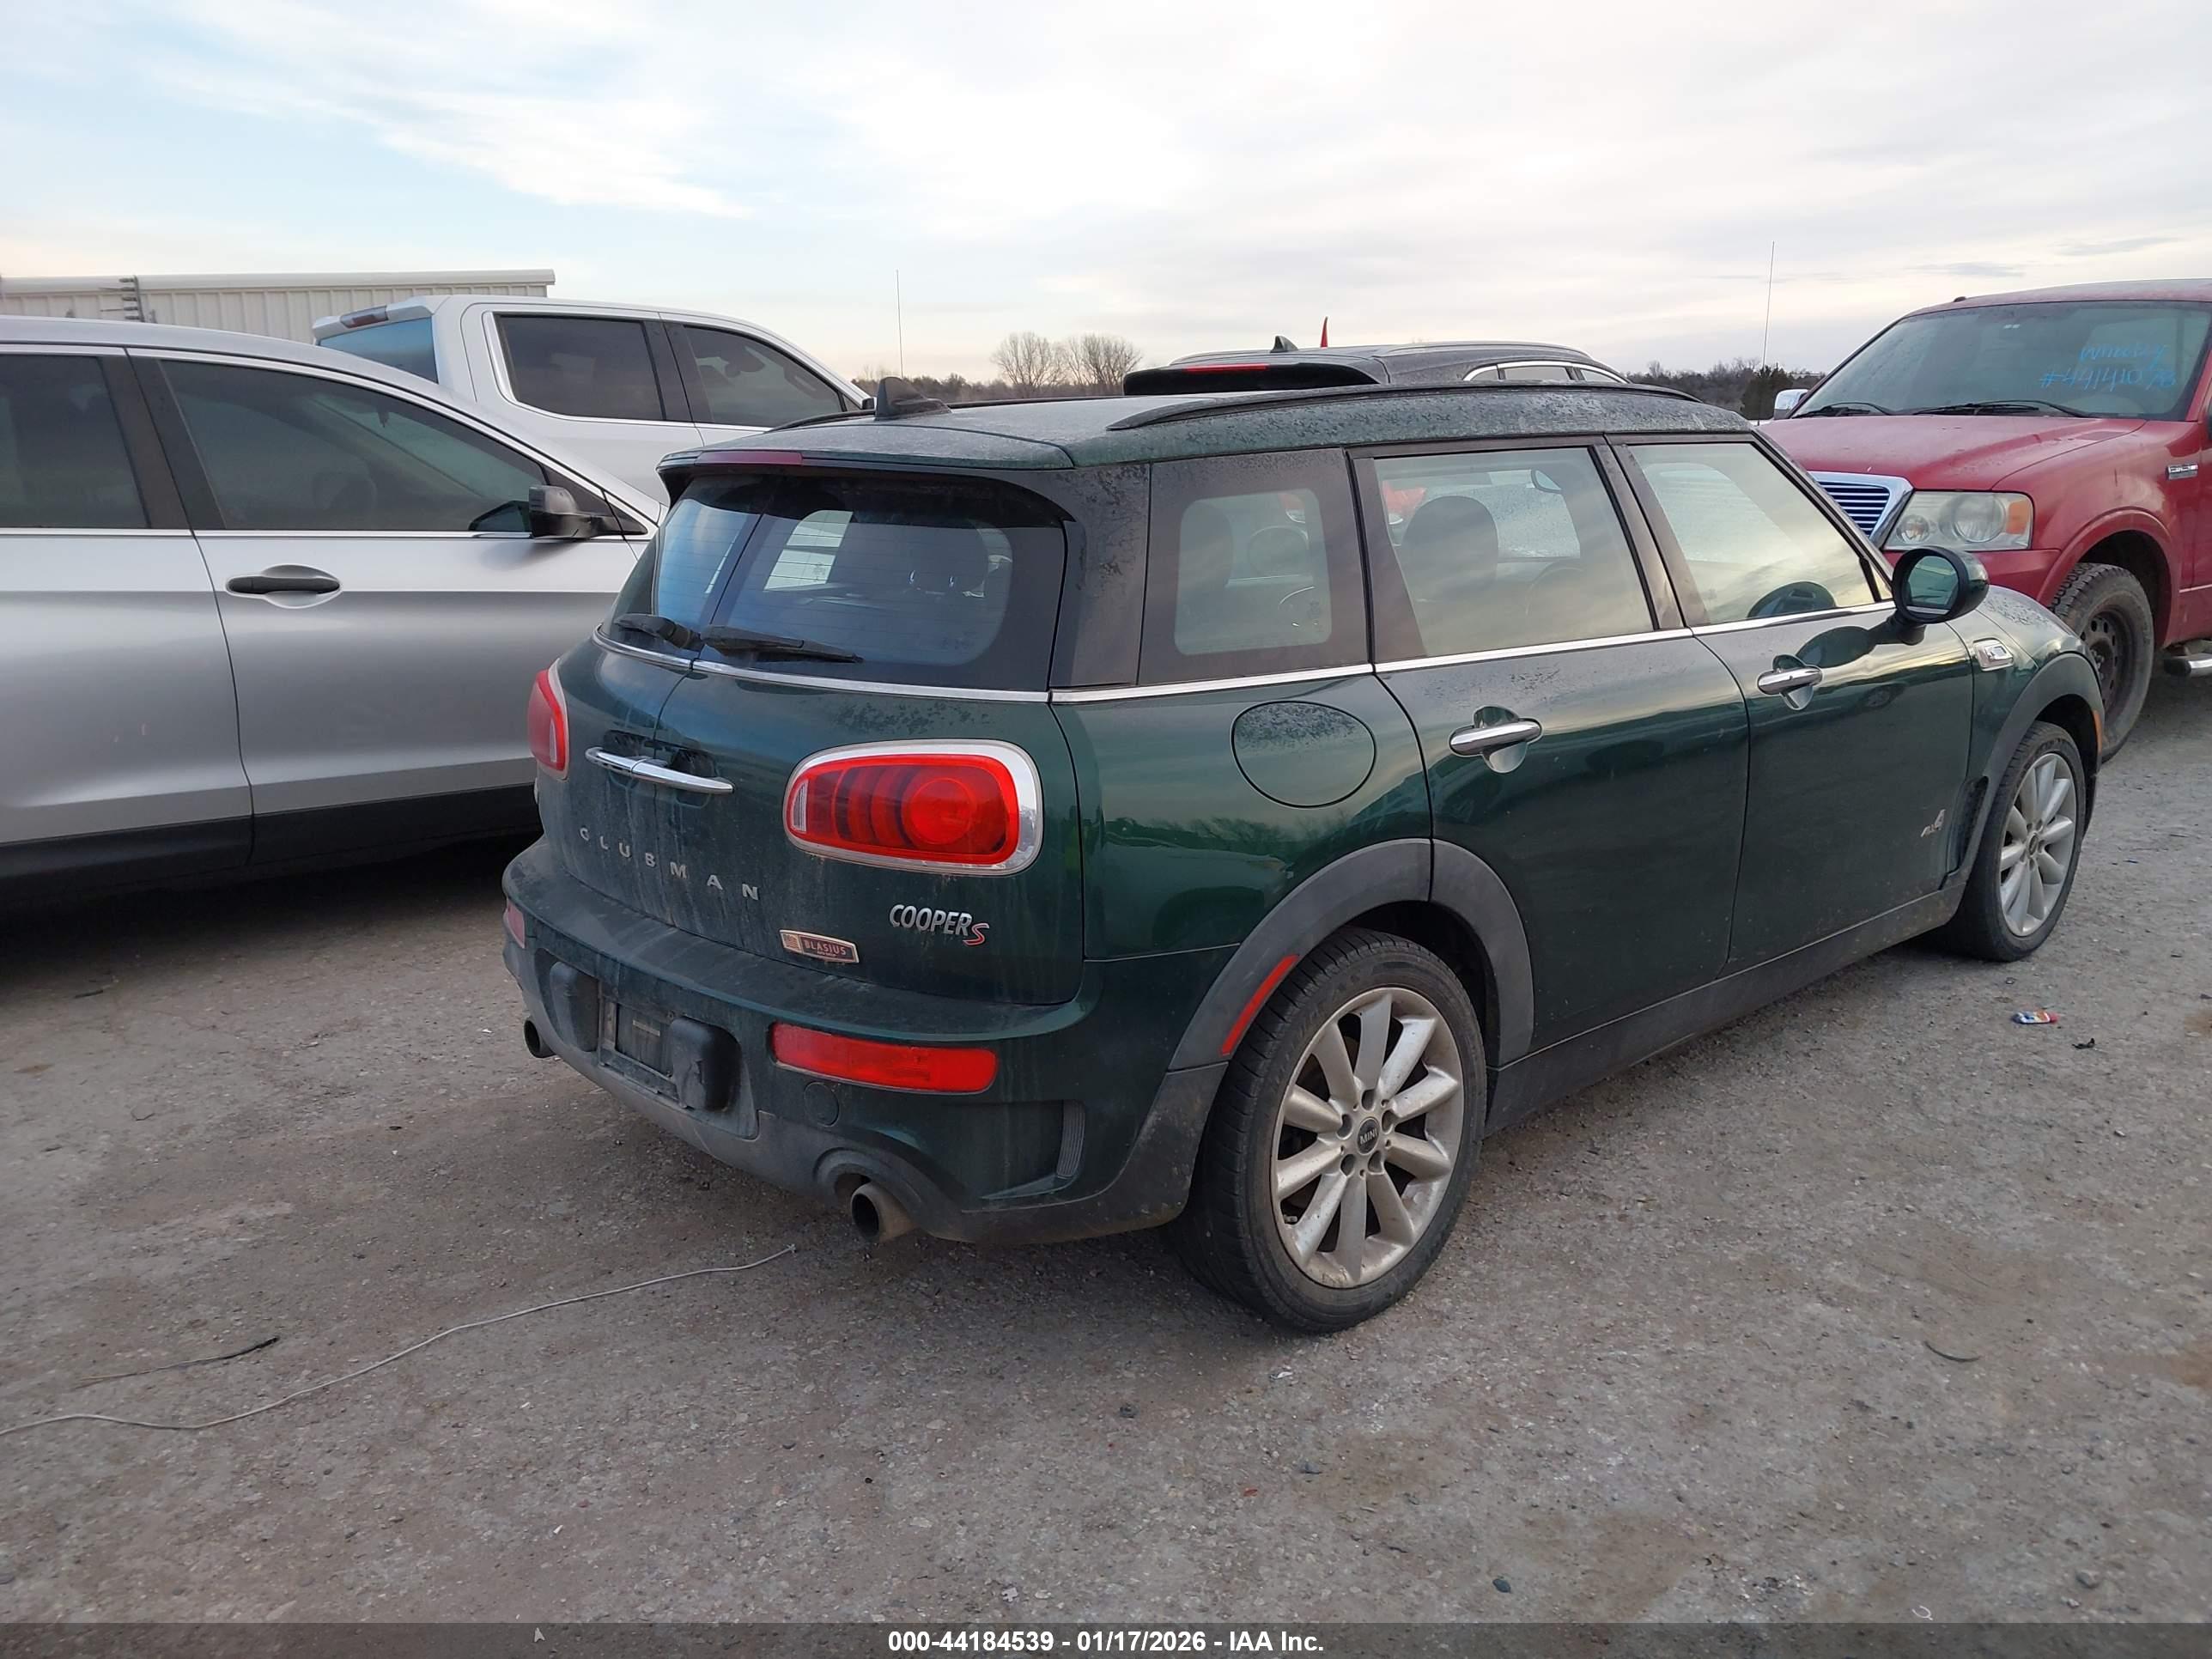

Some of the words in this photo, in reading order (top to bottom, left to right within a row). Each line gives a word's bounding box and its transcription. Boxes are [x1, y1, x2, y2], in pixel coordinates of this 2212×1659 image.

[580, 827, 759, 901] CLUBMAN
[889, 904, 973, 937] COOPER
[963, 921, 990, 946] S
[803, 939, 848, 956] BLASIUS
[1359, 1127, 1378, 1145] MINI
